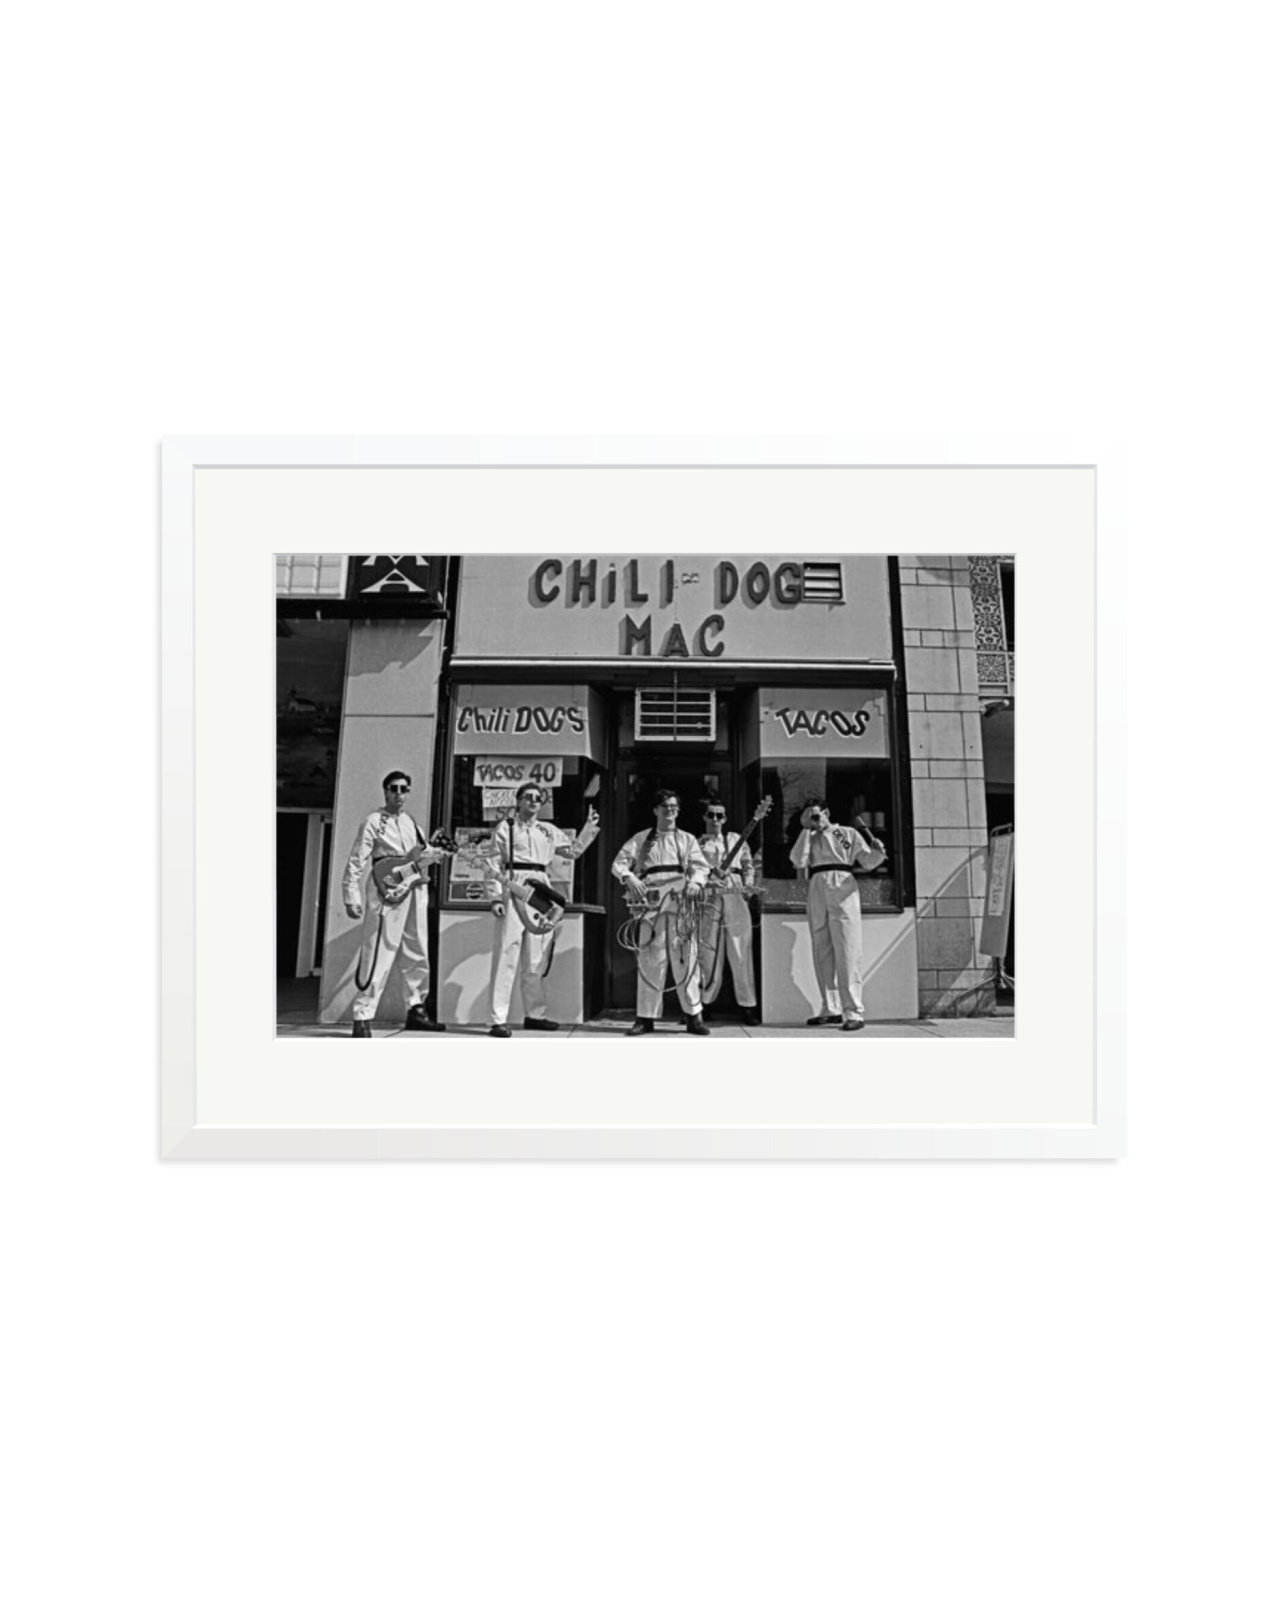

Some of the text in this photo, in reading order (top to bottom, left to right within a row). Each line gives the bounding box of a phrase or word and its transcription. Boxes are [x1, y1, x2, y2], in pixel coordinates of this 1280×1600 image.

[618, 613, 726, 658] MAC
[457, 706, 584, 735] Chili DOGS
[775, 707, 871, 738] TACOS
[476, 762, 556, 784] TACOS 40
